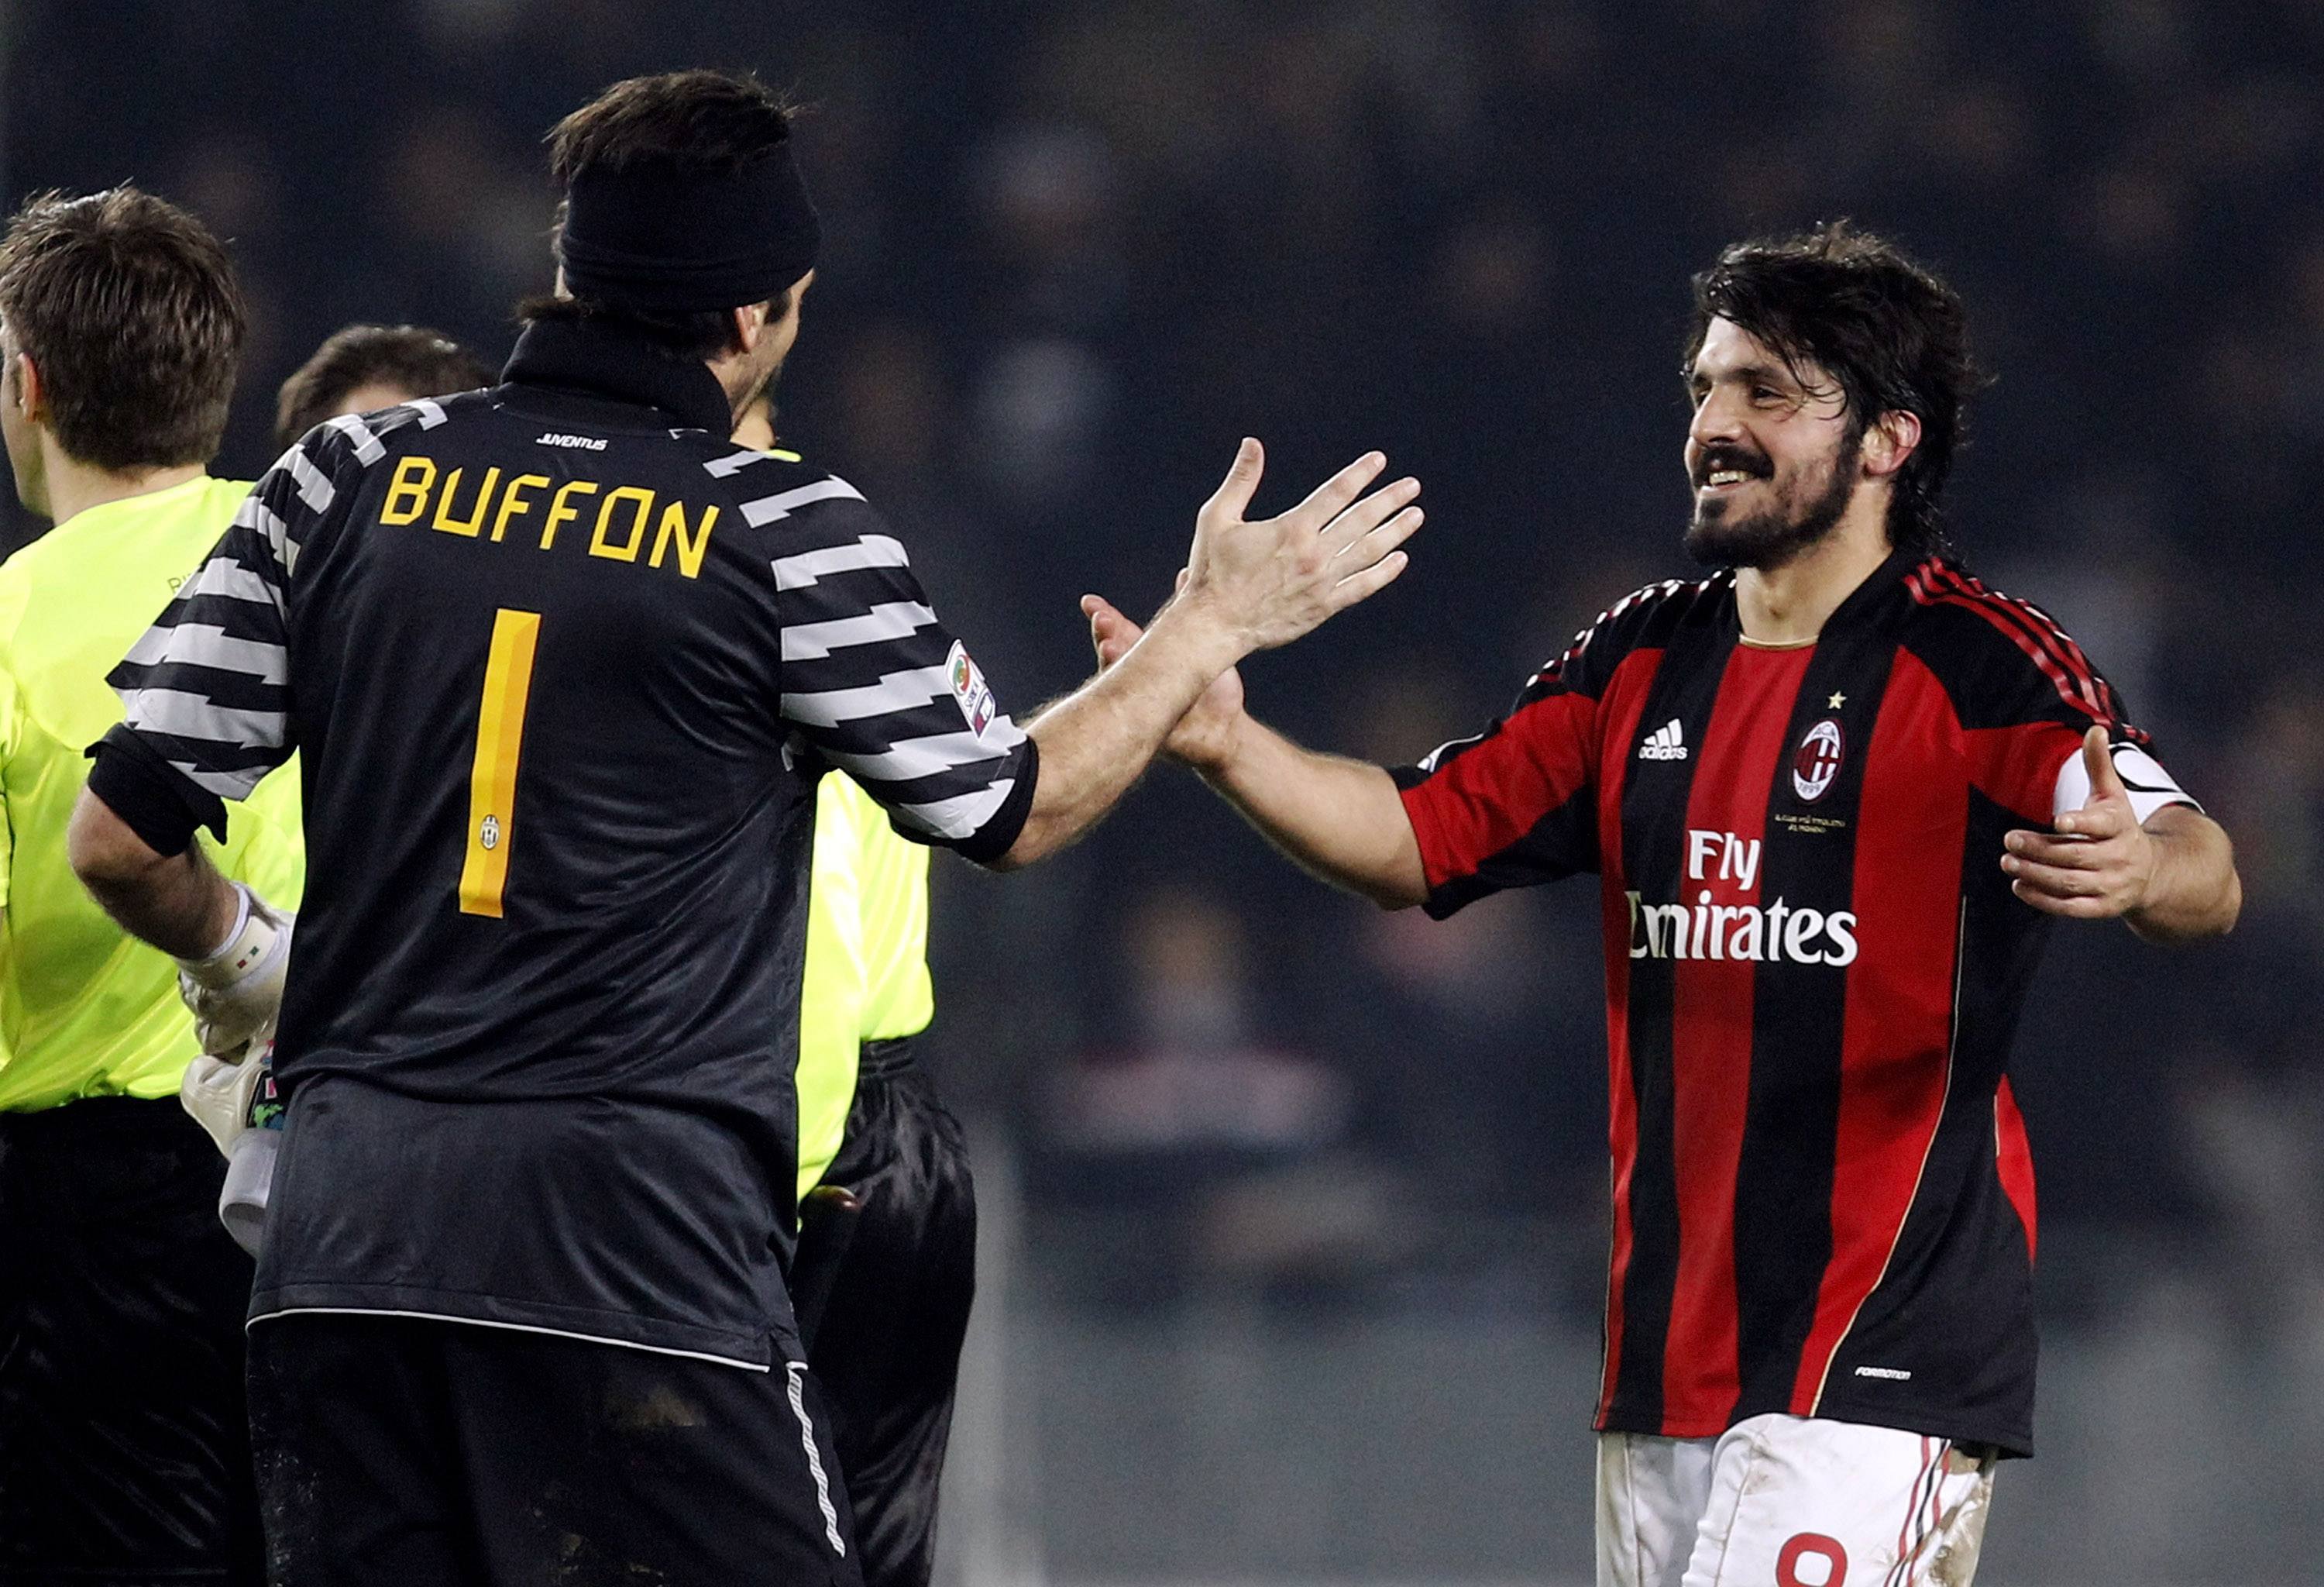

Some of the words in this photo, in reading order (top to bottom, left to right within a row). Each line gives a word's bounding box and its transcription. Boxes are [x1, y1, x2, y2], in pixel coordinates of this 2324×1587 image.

[535, 432, 608, 451] JUVENTUS
[379, 456, 720, 579] BUFFON
[459, 608, 541, 918] 1
[1638, 745, 1689, 761] adidas
[1689, 829, 1761, 890] Fly
